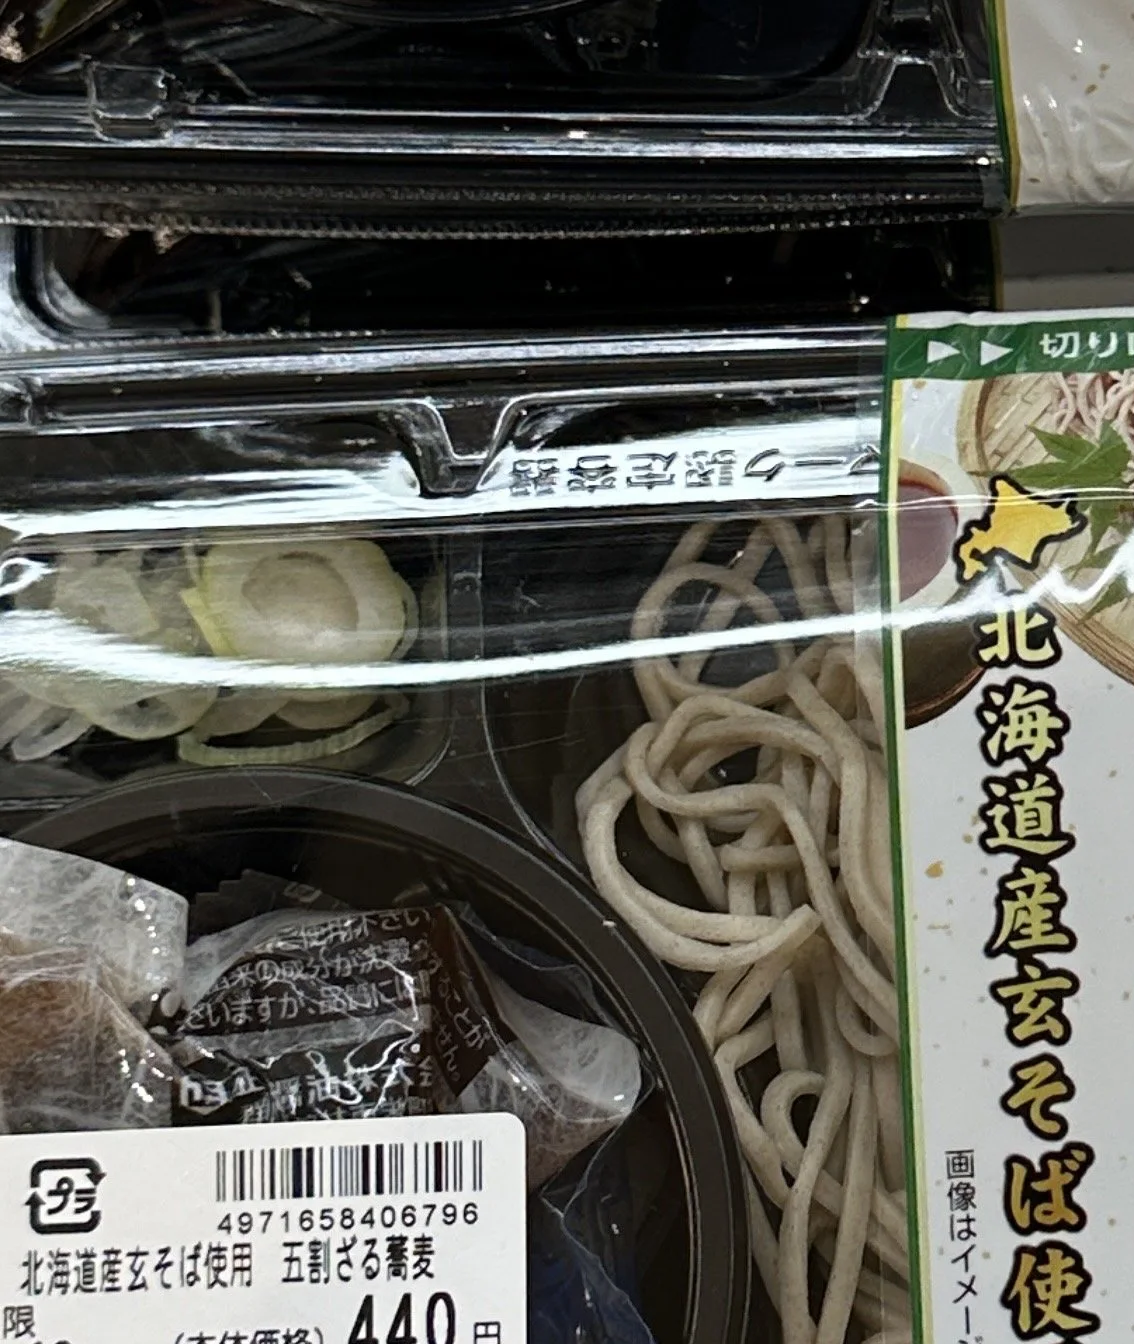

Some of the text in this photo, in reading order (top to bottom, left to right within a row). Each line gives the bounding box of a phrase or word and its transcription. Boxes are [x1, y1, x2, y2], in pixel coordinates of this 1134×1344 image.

[46, 1176, 97, 1215] プラ
[218, 1202, 478, 1234] 4971658406796
[21, 1235, 435, 1296] 北海道産玄そば使用 五割ざる蕎麦
